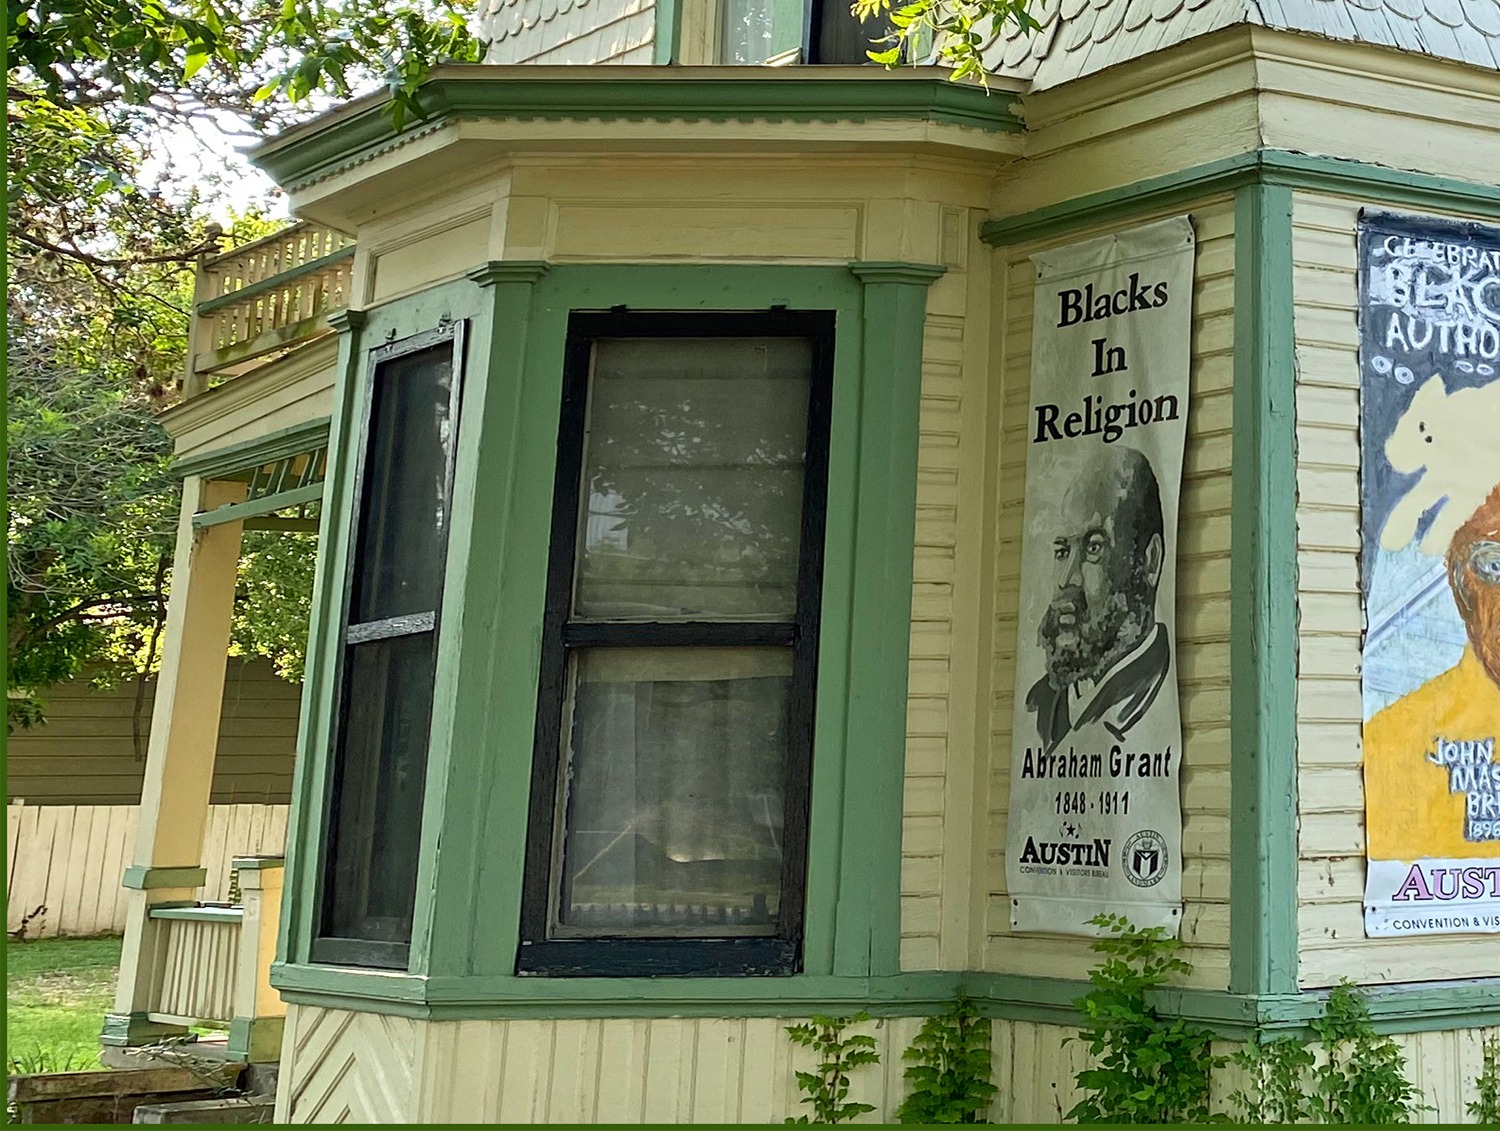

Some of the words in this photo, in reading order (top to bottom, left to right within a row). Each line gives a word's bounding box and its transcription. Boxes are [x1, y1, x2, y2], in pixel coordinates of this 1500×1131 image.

[1056, 272, 1169, 328] Blacks
[1091, 337, 1128, 377] In
[1033, 389, 1180, 443] Religion
[1021, 745, 1102, 779] Abraham
[1109, 744, 1171, 778] Grant
[1428, 738, 1493, 765] JOHN
[1055, 791, 1086, 815] 1848
[1099, 791, 1130, 815] 1911
[1019, 836, 1111, 867] AUSTIN
[1393, 917, 1470, 930] CONVENTION
[1473, 916, 1480, 927] &
